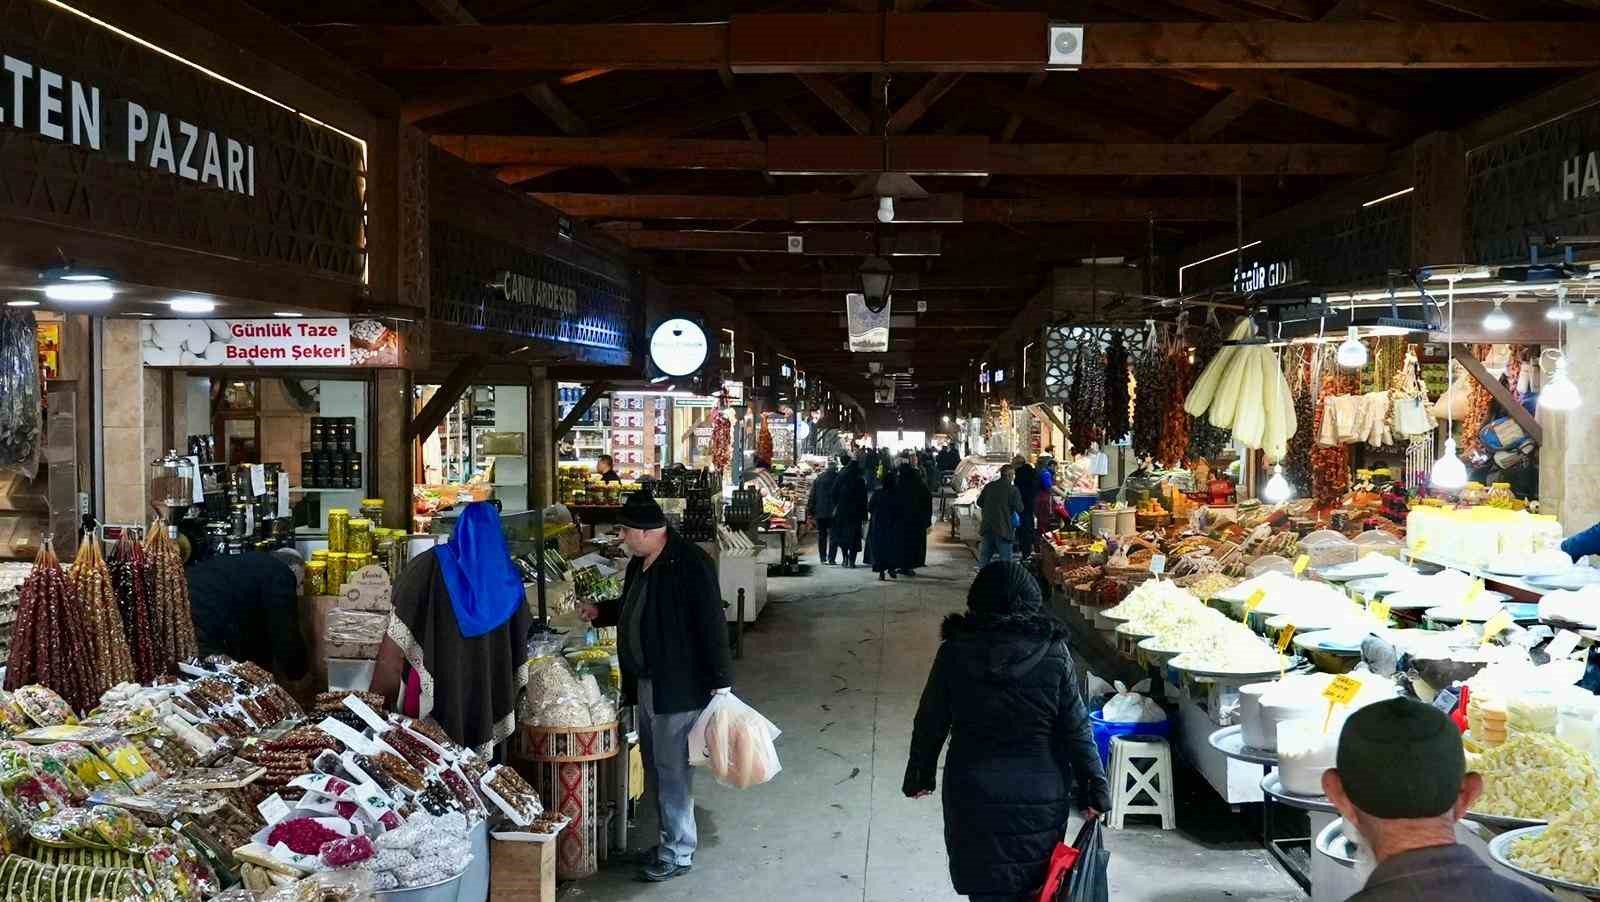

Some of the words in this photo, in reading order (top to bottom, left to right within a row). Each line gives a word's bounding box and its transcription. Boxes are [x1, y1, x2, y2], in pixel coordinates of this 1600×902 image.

[0, 55, 100, 150] TEN
[128, 101, 255, 197] PAZARI
[232, 323, 292, 337] Günlük
[297, 323, 338, 337] Taze
[226, 345, 286, 359] Badem
[292, 344, 345, 360] Şekeri
